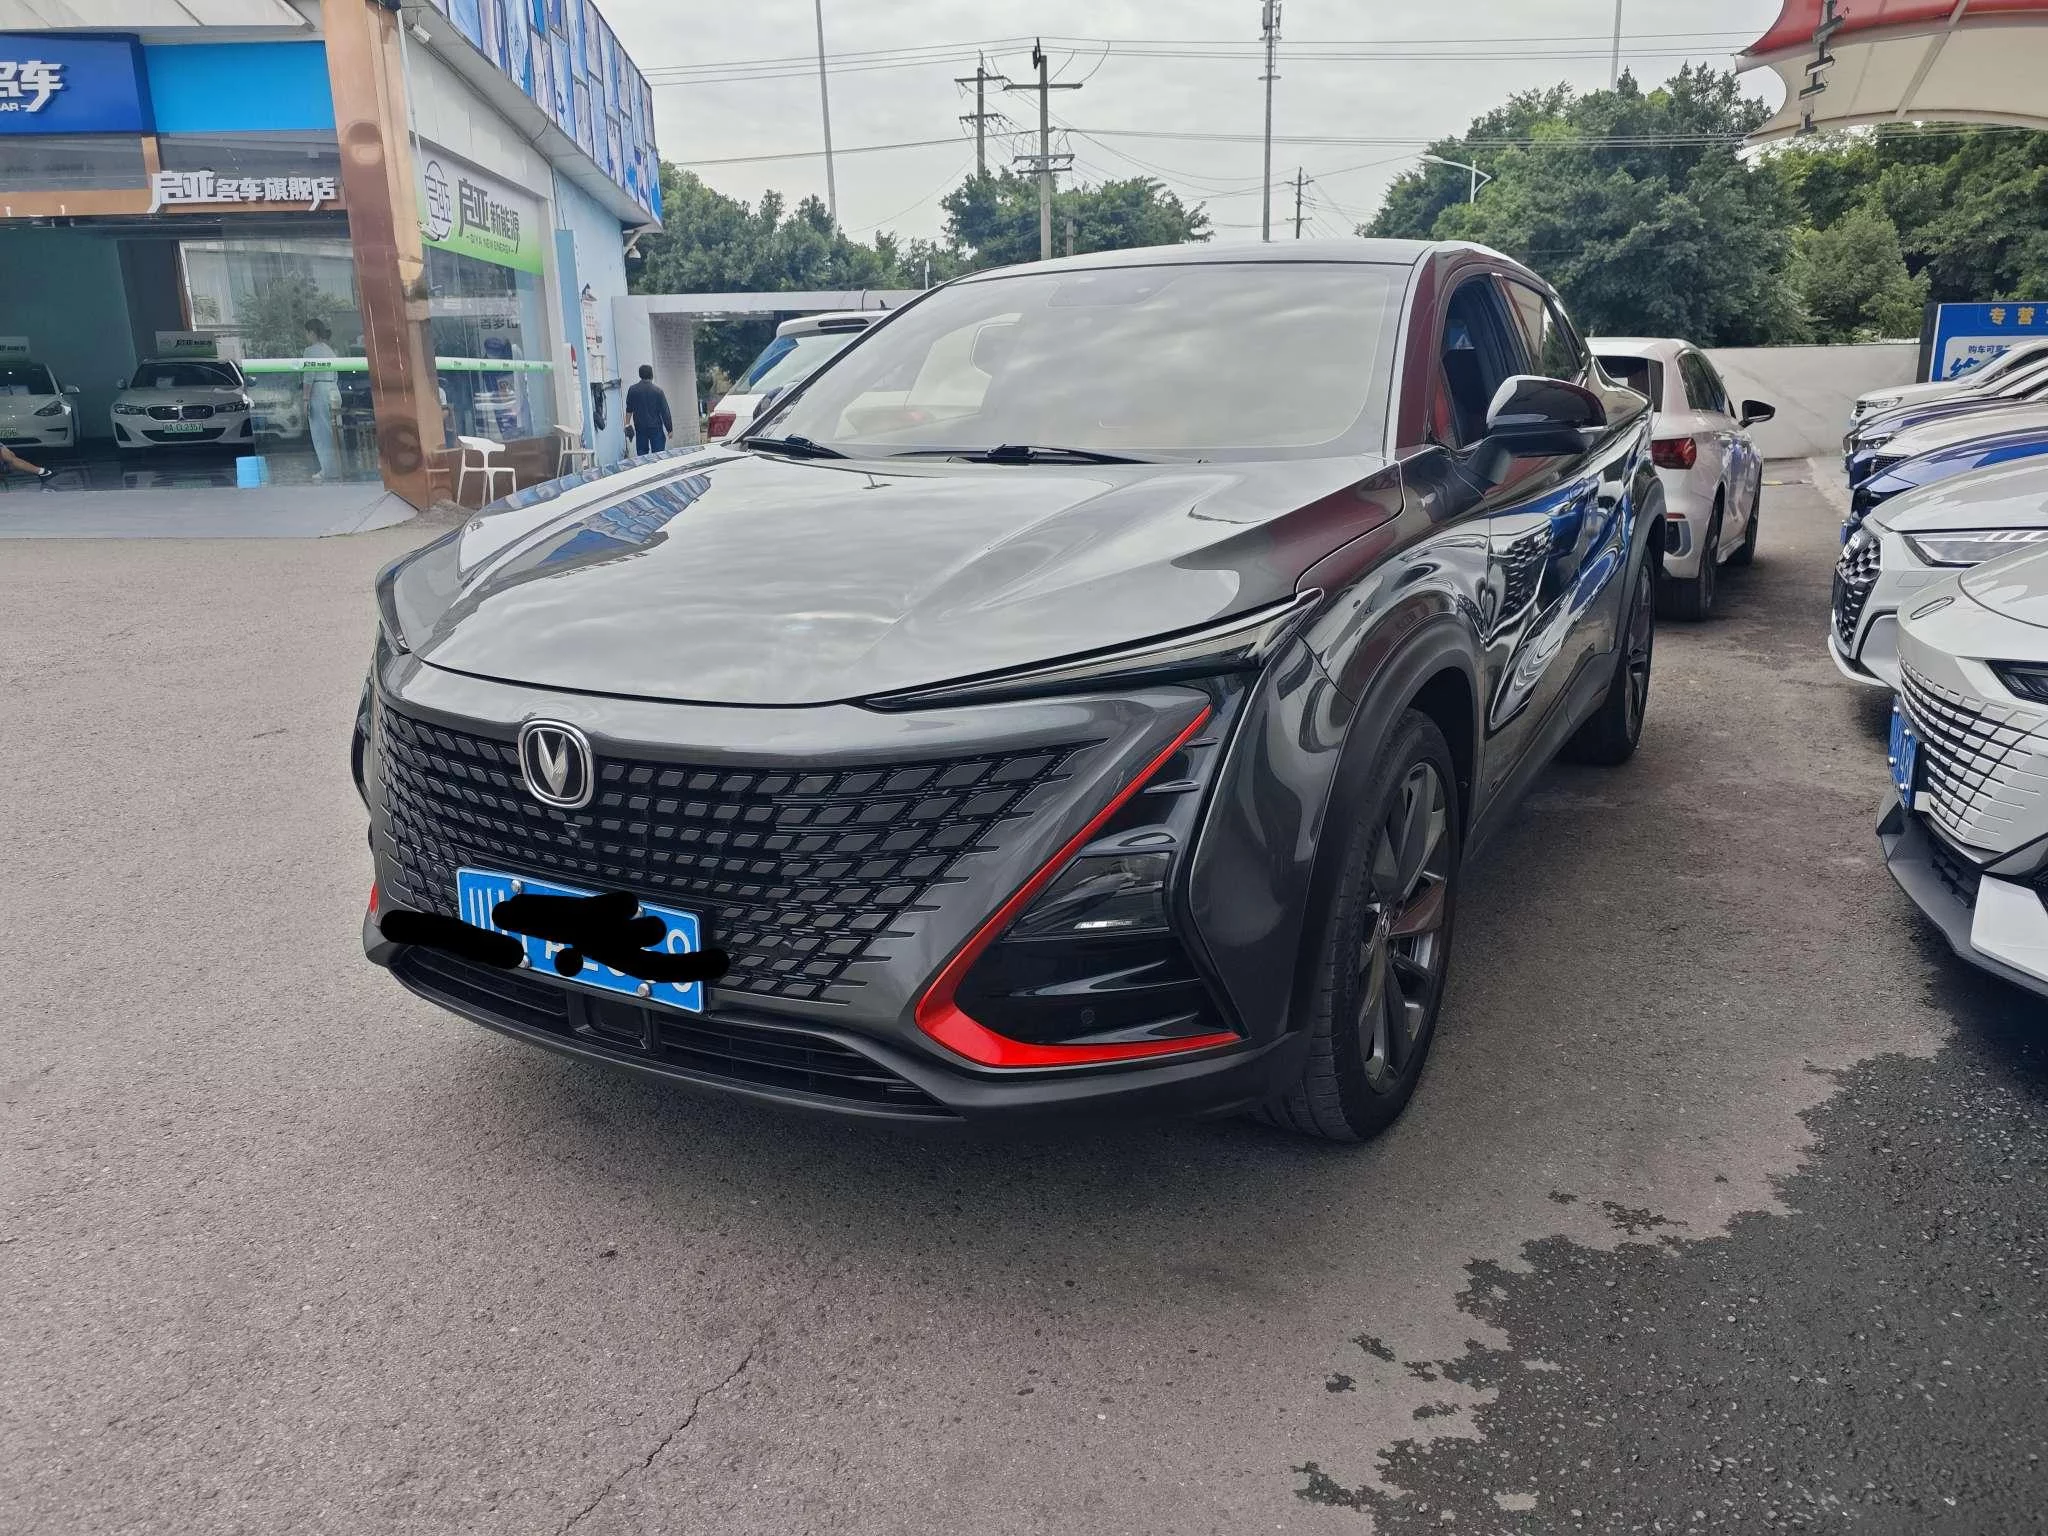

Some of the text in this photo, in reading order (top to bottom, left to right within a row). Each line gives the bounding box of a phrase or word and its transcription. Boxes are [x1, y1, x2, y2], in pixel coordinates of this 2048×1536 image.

[0, 102, 19, 112] AR
[147, 170, 336, 214] 启亚名车旗舰店
[458, 178, 520, 254] 启亚新能源
